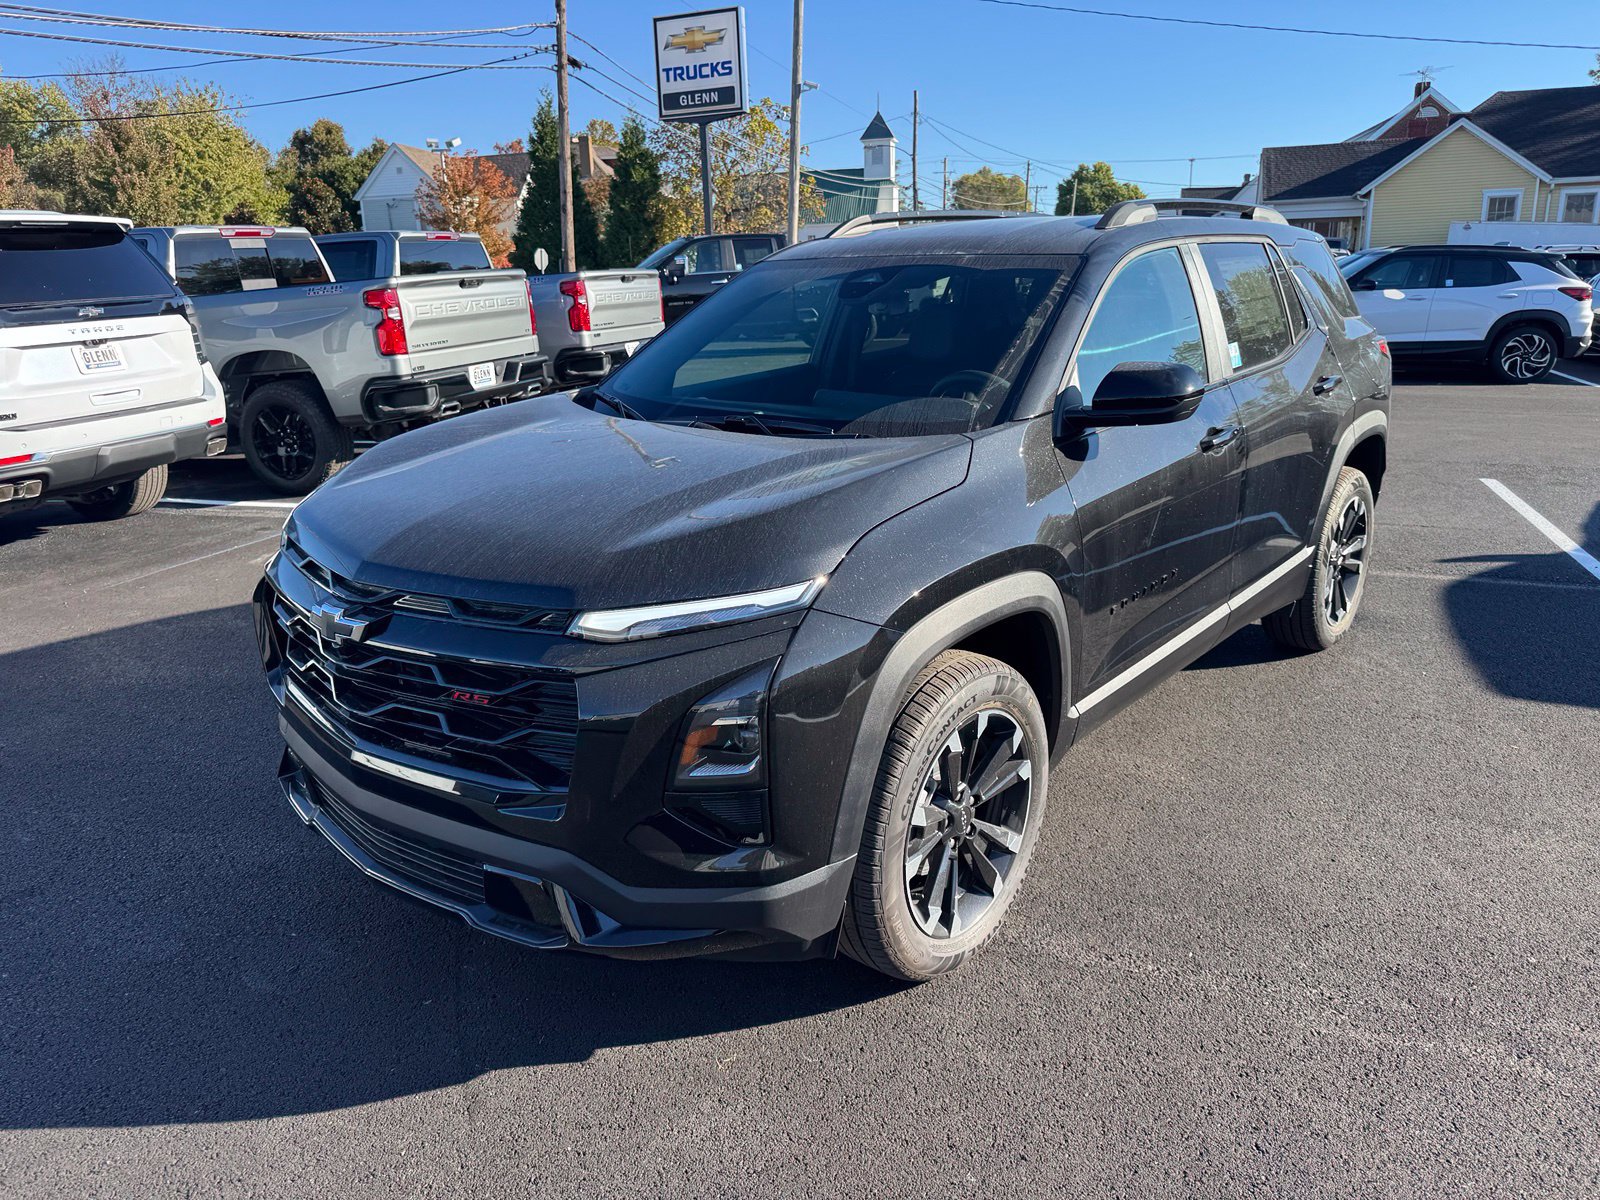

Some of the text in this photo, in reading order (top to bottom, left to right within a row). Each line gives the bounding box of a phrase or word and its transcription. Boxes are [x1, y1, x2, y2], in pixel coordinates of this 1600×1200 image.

[662, 60, 733, 83] TRUCKS
[679, 91, 719, 106] GLENN
[595, 290, 658, 304] CHEVROLET
[415, 295, 523, 318] CHEVROLET
[67, 324, 124, 335] TAHOE
[82, 348, 118, 364] GLENN
[453, 691, 490, 705] RS
[900, 693, 978, 821] CROSSCONTACT
